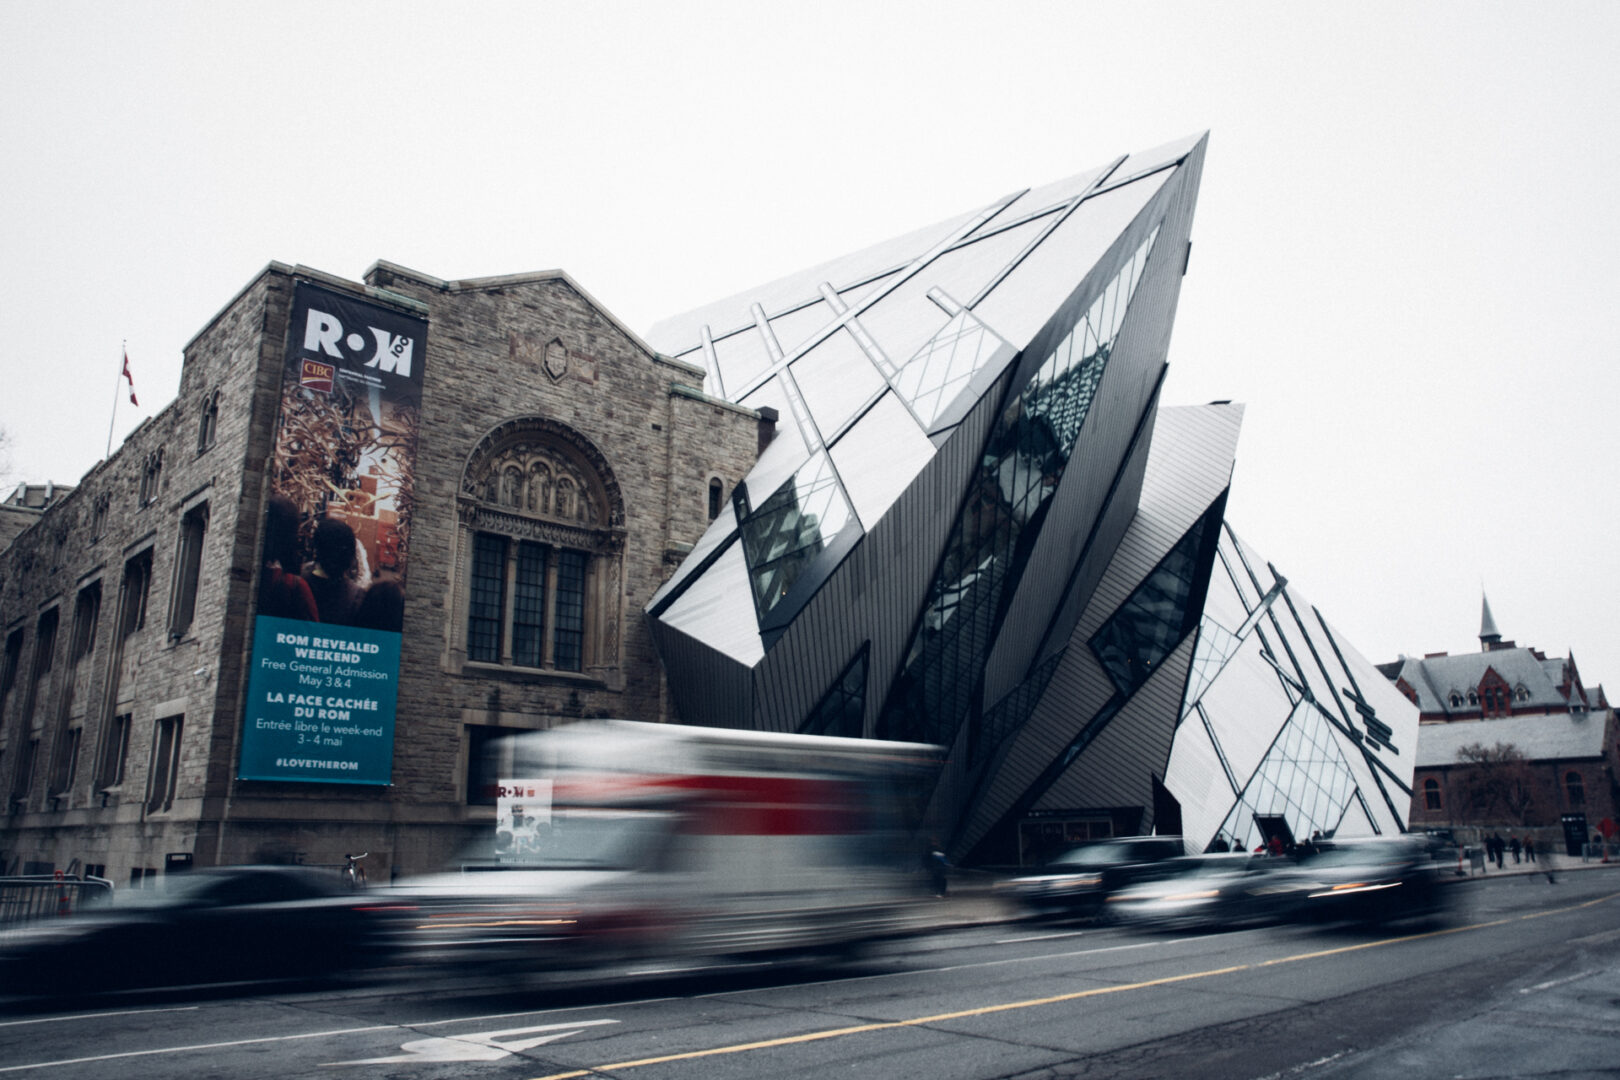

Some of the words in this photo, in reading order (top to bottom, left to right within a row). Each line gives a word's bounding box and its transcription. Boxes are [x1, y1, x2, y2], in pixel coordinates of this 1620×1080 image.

[304, 362, 332, 378] CIBC
[276, 633, 308, 646] ROM
[313, 637, 379, 654] REVEALED
[295, 648, 360, 664] WEEKEND
[261, 658, 287, 670] Free
[289, 661, 332, 675] General
[335, 666, 388, 680] Admission
[299, 675, 322, 688] May
[325, 677, 332, 687] 3
[334, 678, 342, 687] &
[344, 678, 351, 688] 4
[267, 692, 284, 703] LA
[288, 694, 322, 706] FACE
[326, 697, 378, 711] CACHÉE
[294, 707, 314, 718] DU
[318, 709, 350, 721] ROM
[256, 718, 292, 731] Entrée
[295, 720, 318, 732] libre
[321, 722, 330, 733] le
[333, 725, 383, 737] week-end
[323, 736, 343, 746] mai
[276, 758, 358, 770] #LOVETHEROM
